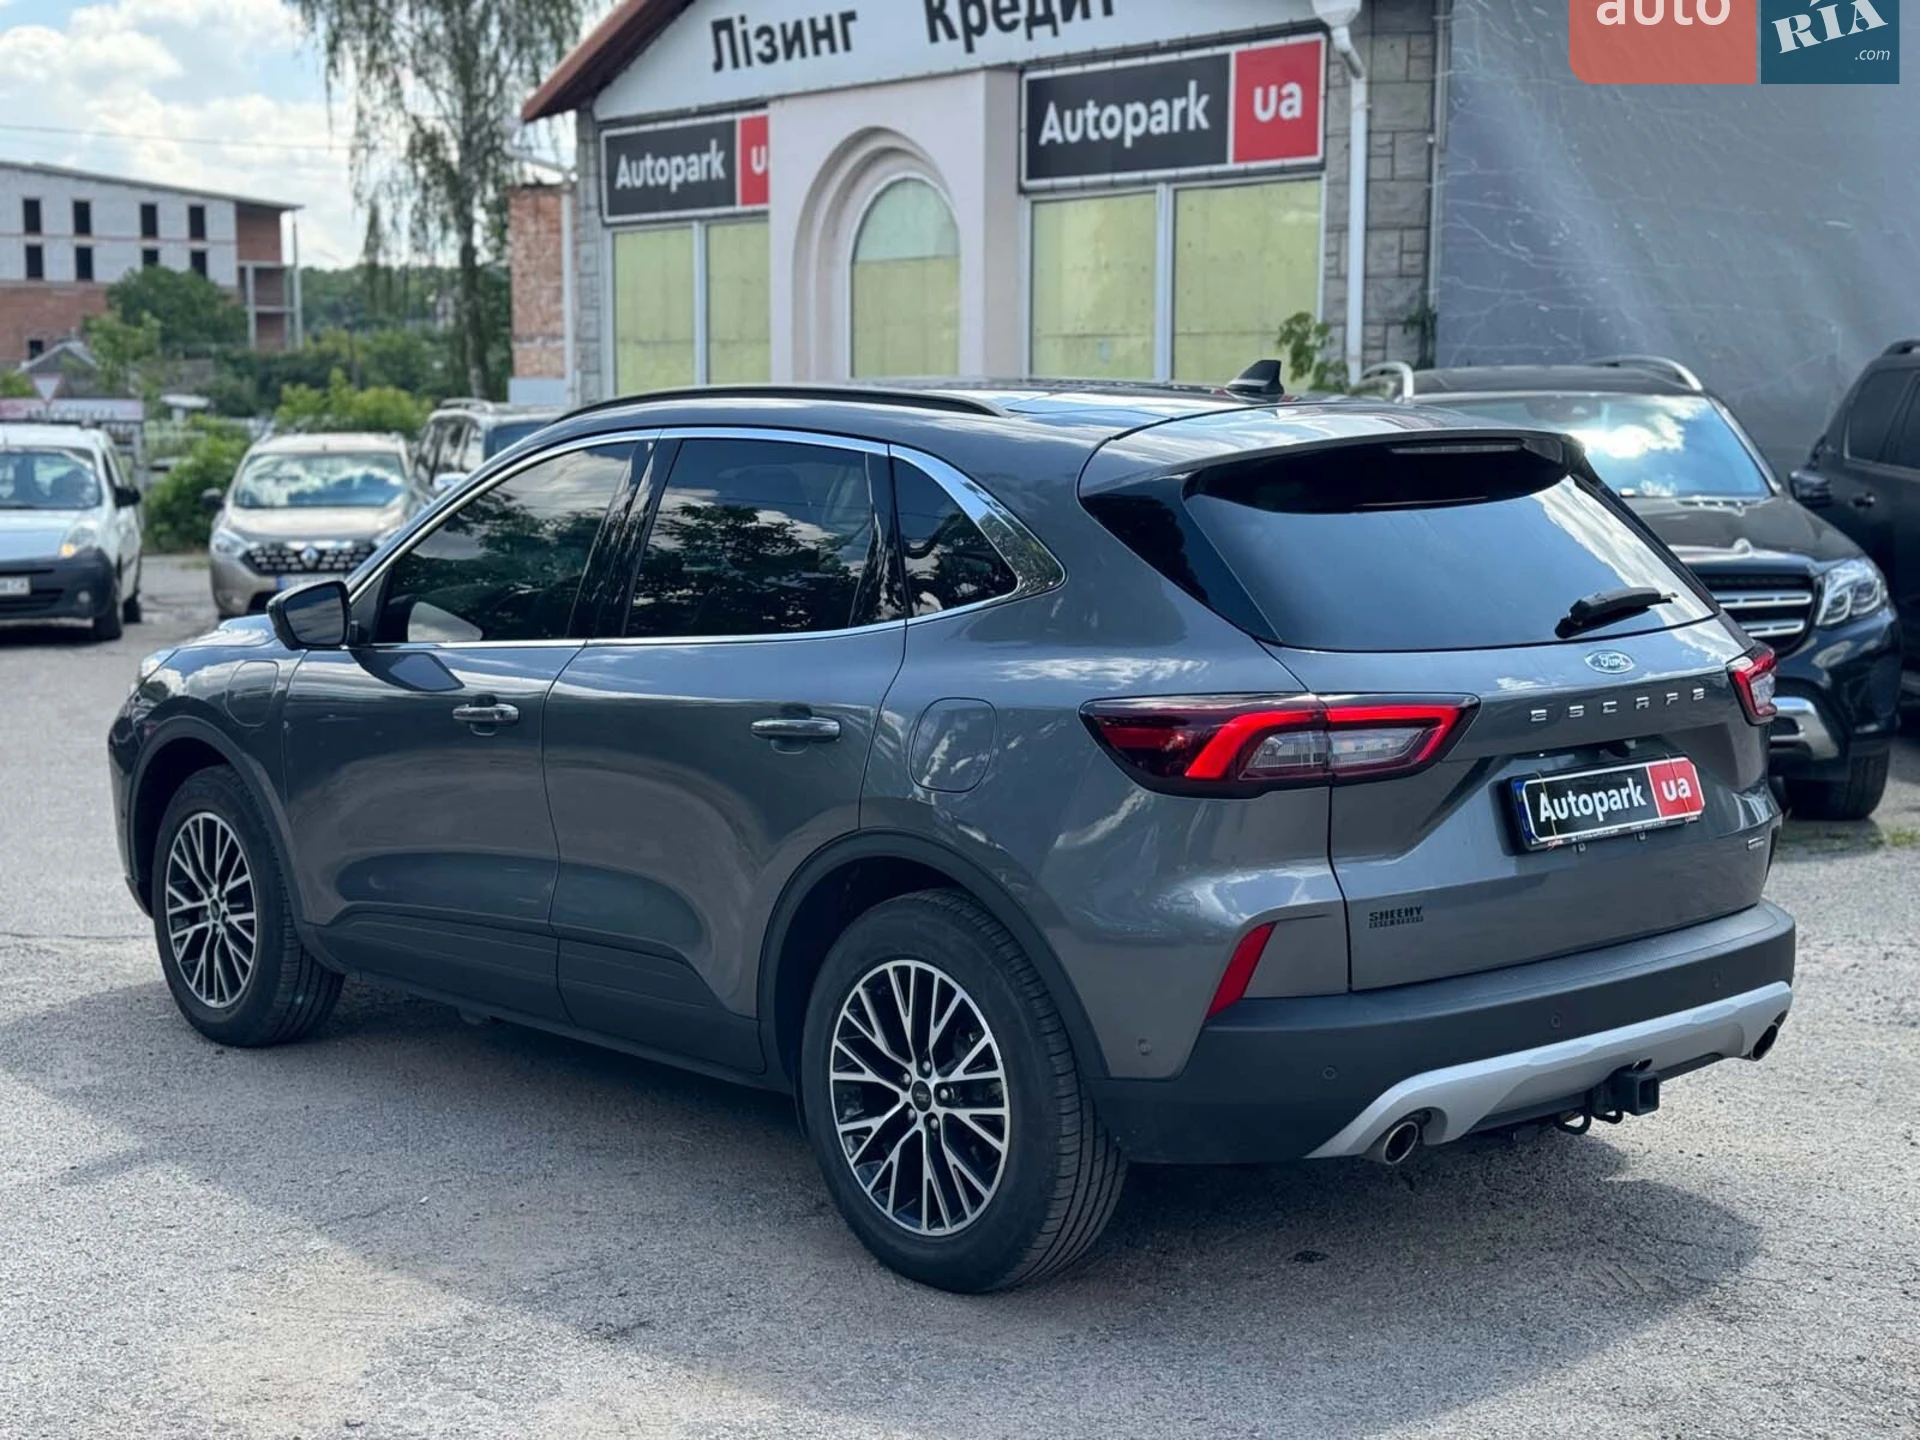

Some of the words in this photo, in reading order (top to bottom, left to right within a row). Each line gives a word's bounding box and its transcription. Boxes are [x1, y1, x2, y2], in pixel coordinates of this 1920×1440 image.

[711, 10, 857, 73] Лізинг
[1039, 79, 1210, 148] Autopark
[1253, 81, 1303, 123] ua
[614, 138, 727, 194] Autopark
[751, 144, 768, 175] u
[1530, 687, 1705, 722] ESCAPE
[1539, 777, 1647, 823] Autopark
[1660, 777, 1692, 802] ua
[1368, 906, 1423, 922] SHEEHY
